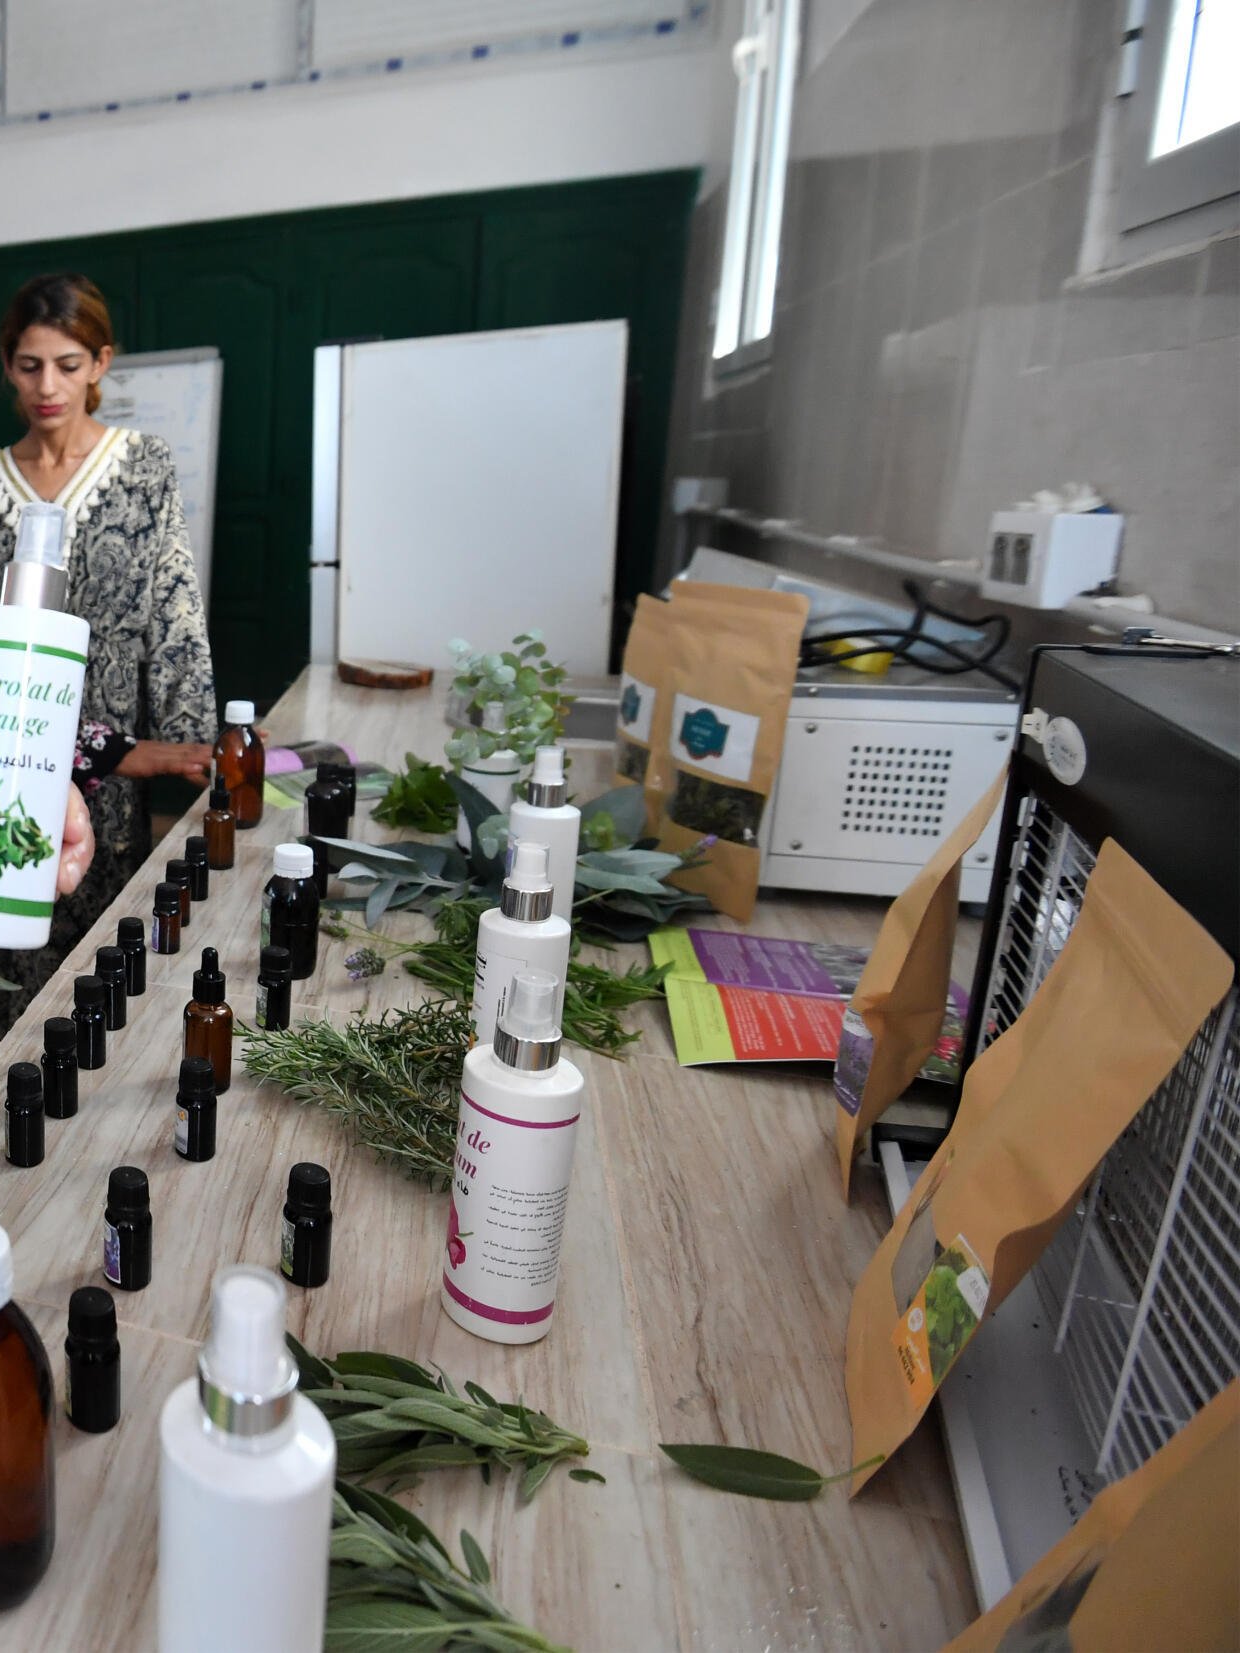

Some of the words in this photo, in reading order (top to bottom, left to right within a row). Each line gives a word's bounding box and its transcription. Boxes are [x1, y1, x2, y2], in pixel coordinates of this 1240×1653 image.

[56, 683, 76, 706] de
[37, 758, 56, 772] ماء
[467, 1130, 491, 1154] de
